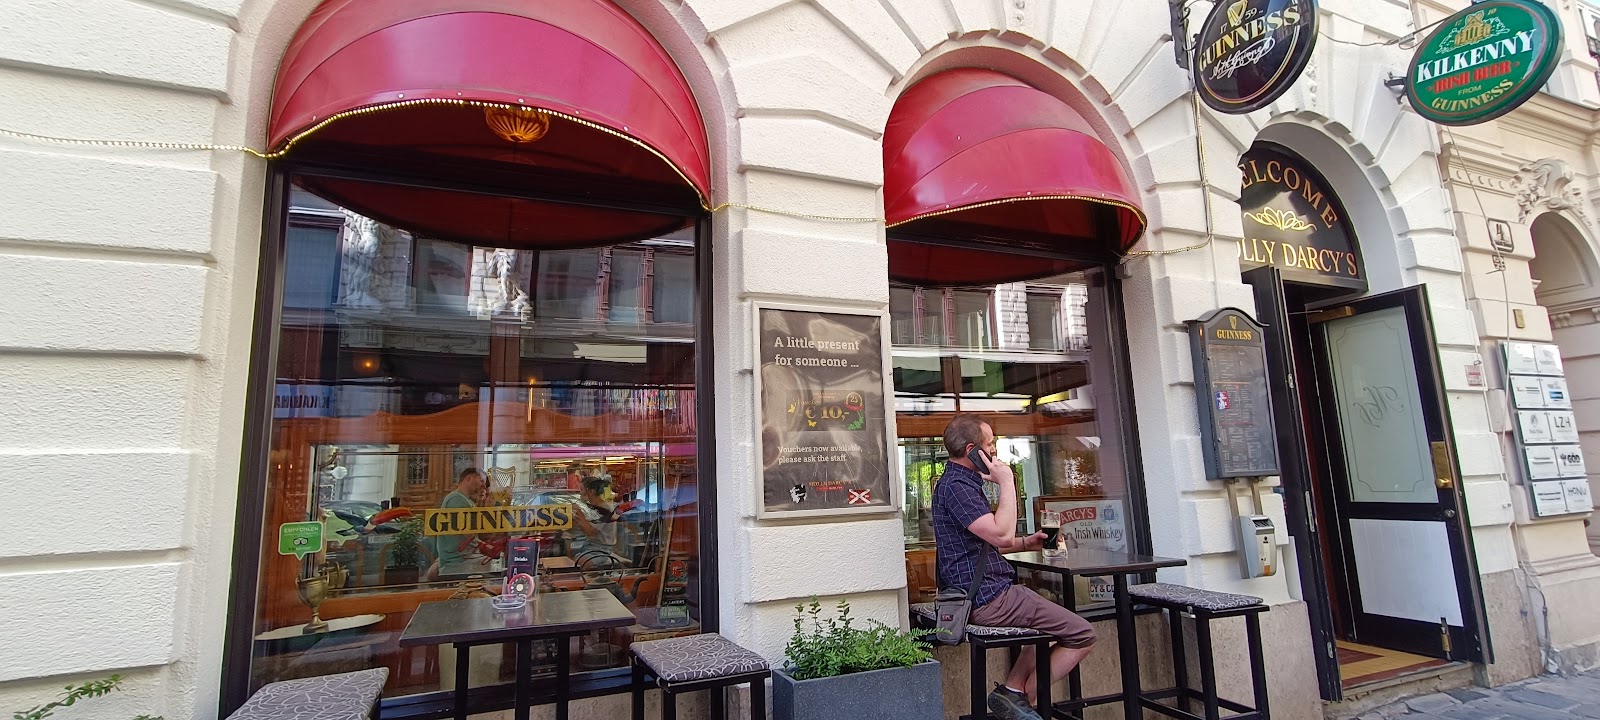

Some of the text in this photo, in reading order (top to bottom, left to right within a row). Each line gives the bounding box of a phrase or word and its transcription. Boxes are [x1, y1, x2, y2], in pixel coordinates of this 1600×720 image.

[1245, 8, 1257, 20] 59
[1200, 6, 1300, 71] GUINNESS
[1416, 28, 1536, 83] KILKENNY
[1434, 60, 1511, 94] IRISH BEER
[1431, 78, 1514, 111] GUINNESS
[1458, 85, 1482, 95] FROM
[1238, 160, 1338, 229] ELCOME
[1495, 223, 1504, 241] 4
[1237, 238, 1357, 276] LLY DARCY'S
[1216, 329, 1252, 340] GUINNESS
[774, 336, 860, 351] A little present
[775, 354, 792, 366] for
[795, 356, 848, 367] someone
[805, 406, 816, 419] €
[778, 445, 812, 453] Vouchers
[778, 456, 802, 465] please
[817, 454, 829, 462] the
[429, 506, 569, 533] GUINNESS
[1060, 507, 1094, 524] ARCY'S
[1074, 526, 1124, 542] Irish Whiskey
[1090, 584, 1099, 593] CY
[1100, 584, 1105, 593] &
